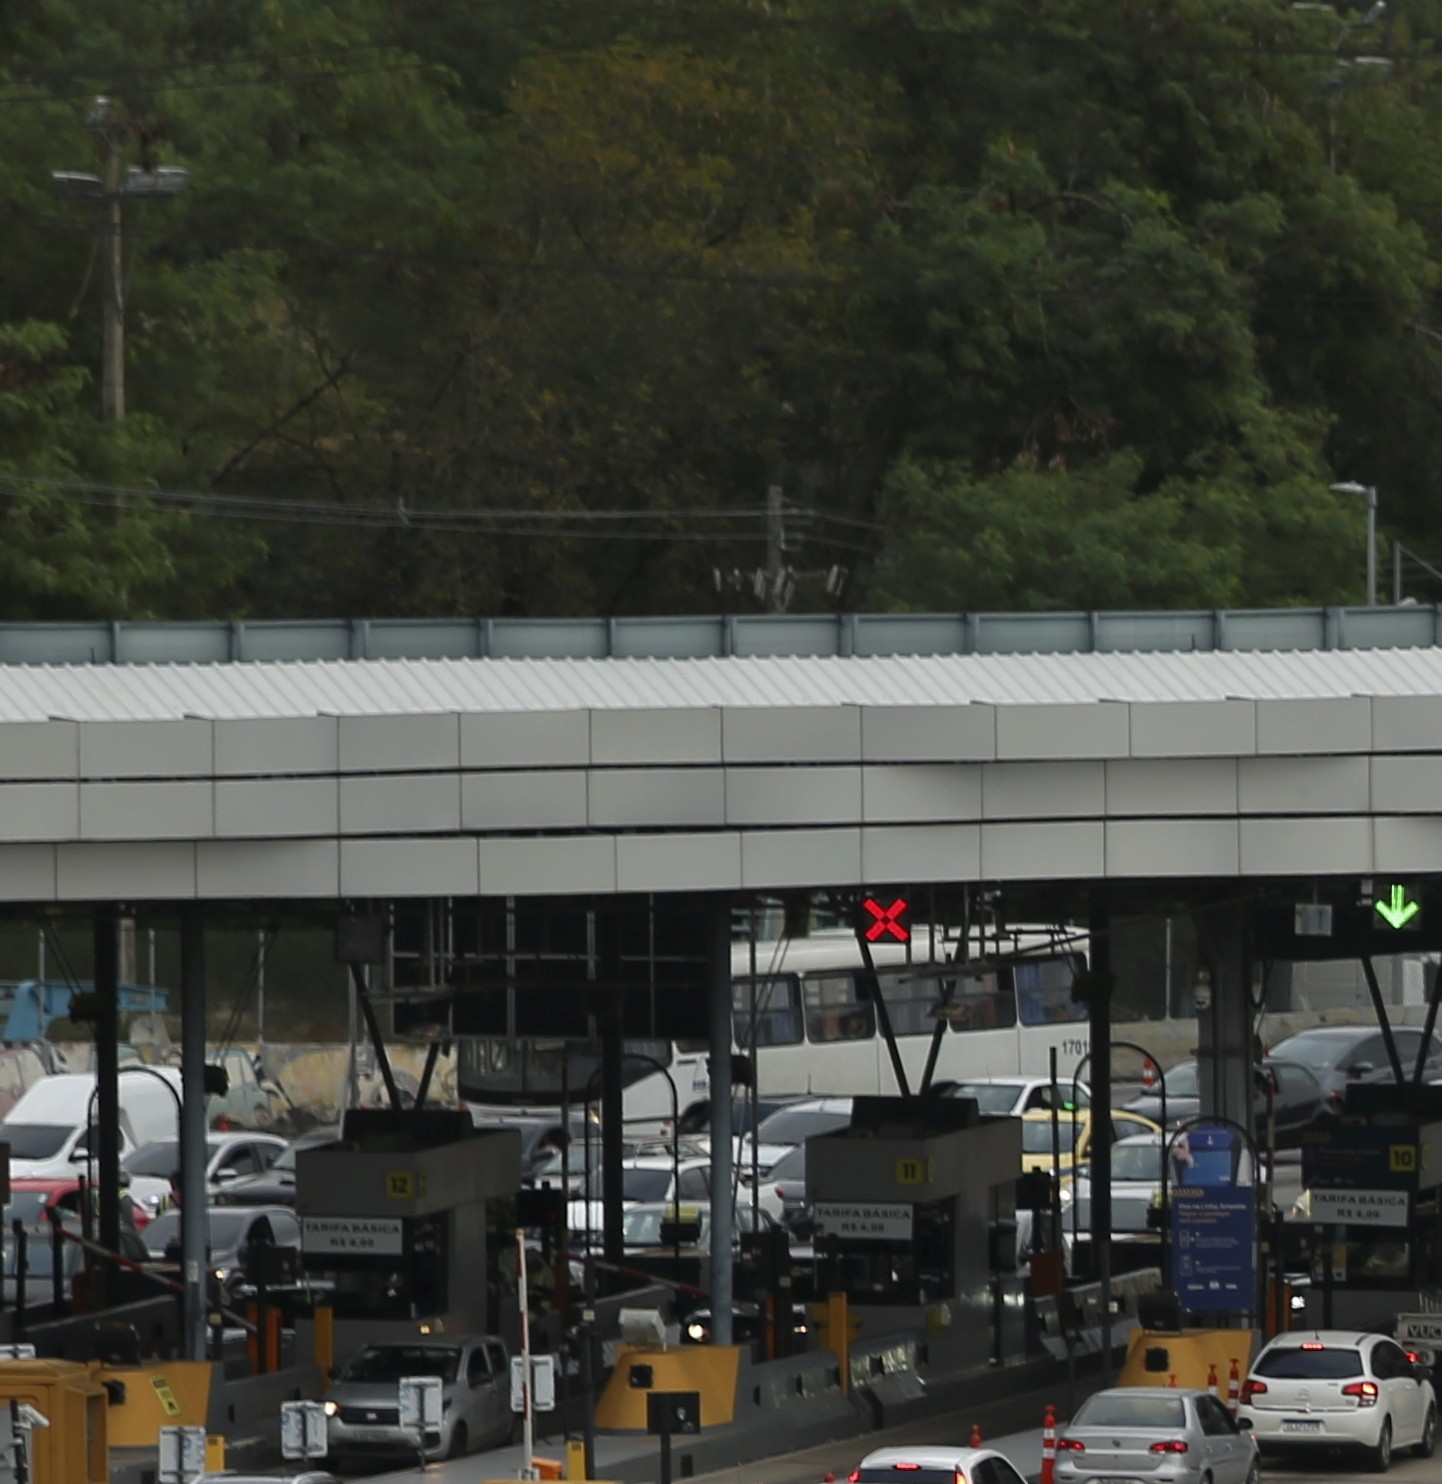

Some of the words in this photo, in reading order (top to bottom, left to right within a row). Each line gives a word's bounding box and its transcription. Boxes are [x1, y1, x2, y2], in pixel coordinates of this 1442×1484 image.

[1394, 1150, 1412, 1167] 10
[903, 1163, 916, 1179] 11
[391, 1176, 408, 1194] 12
